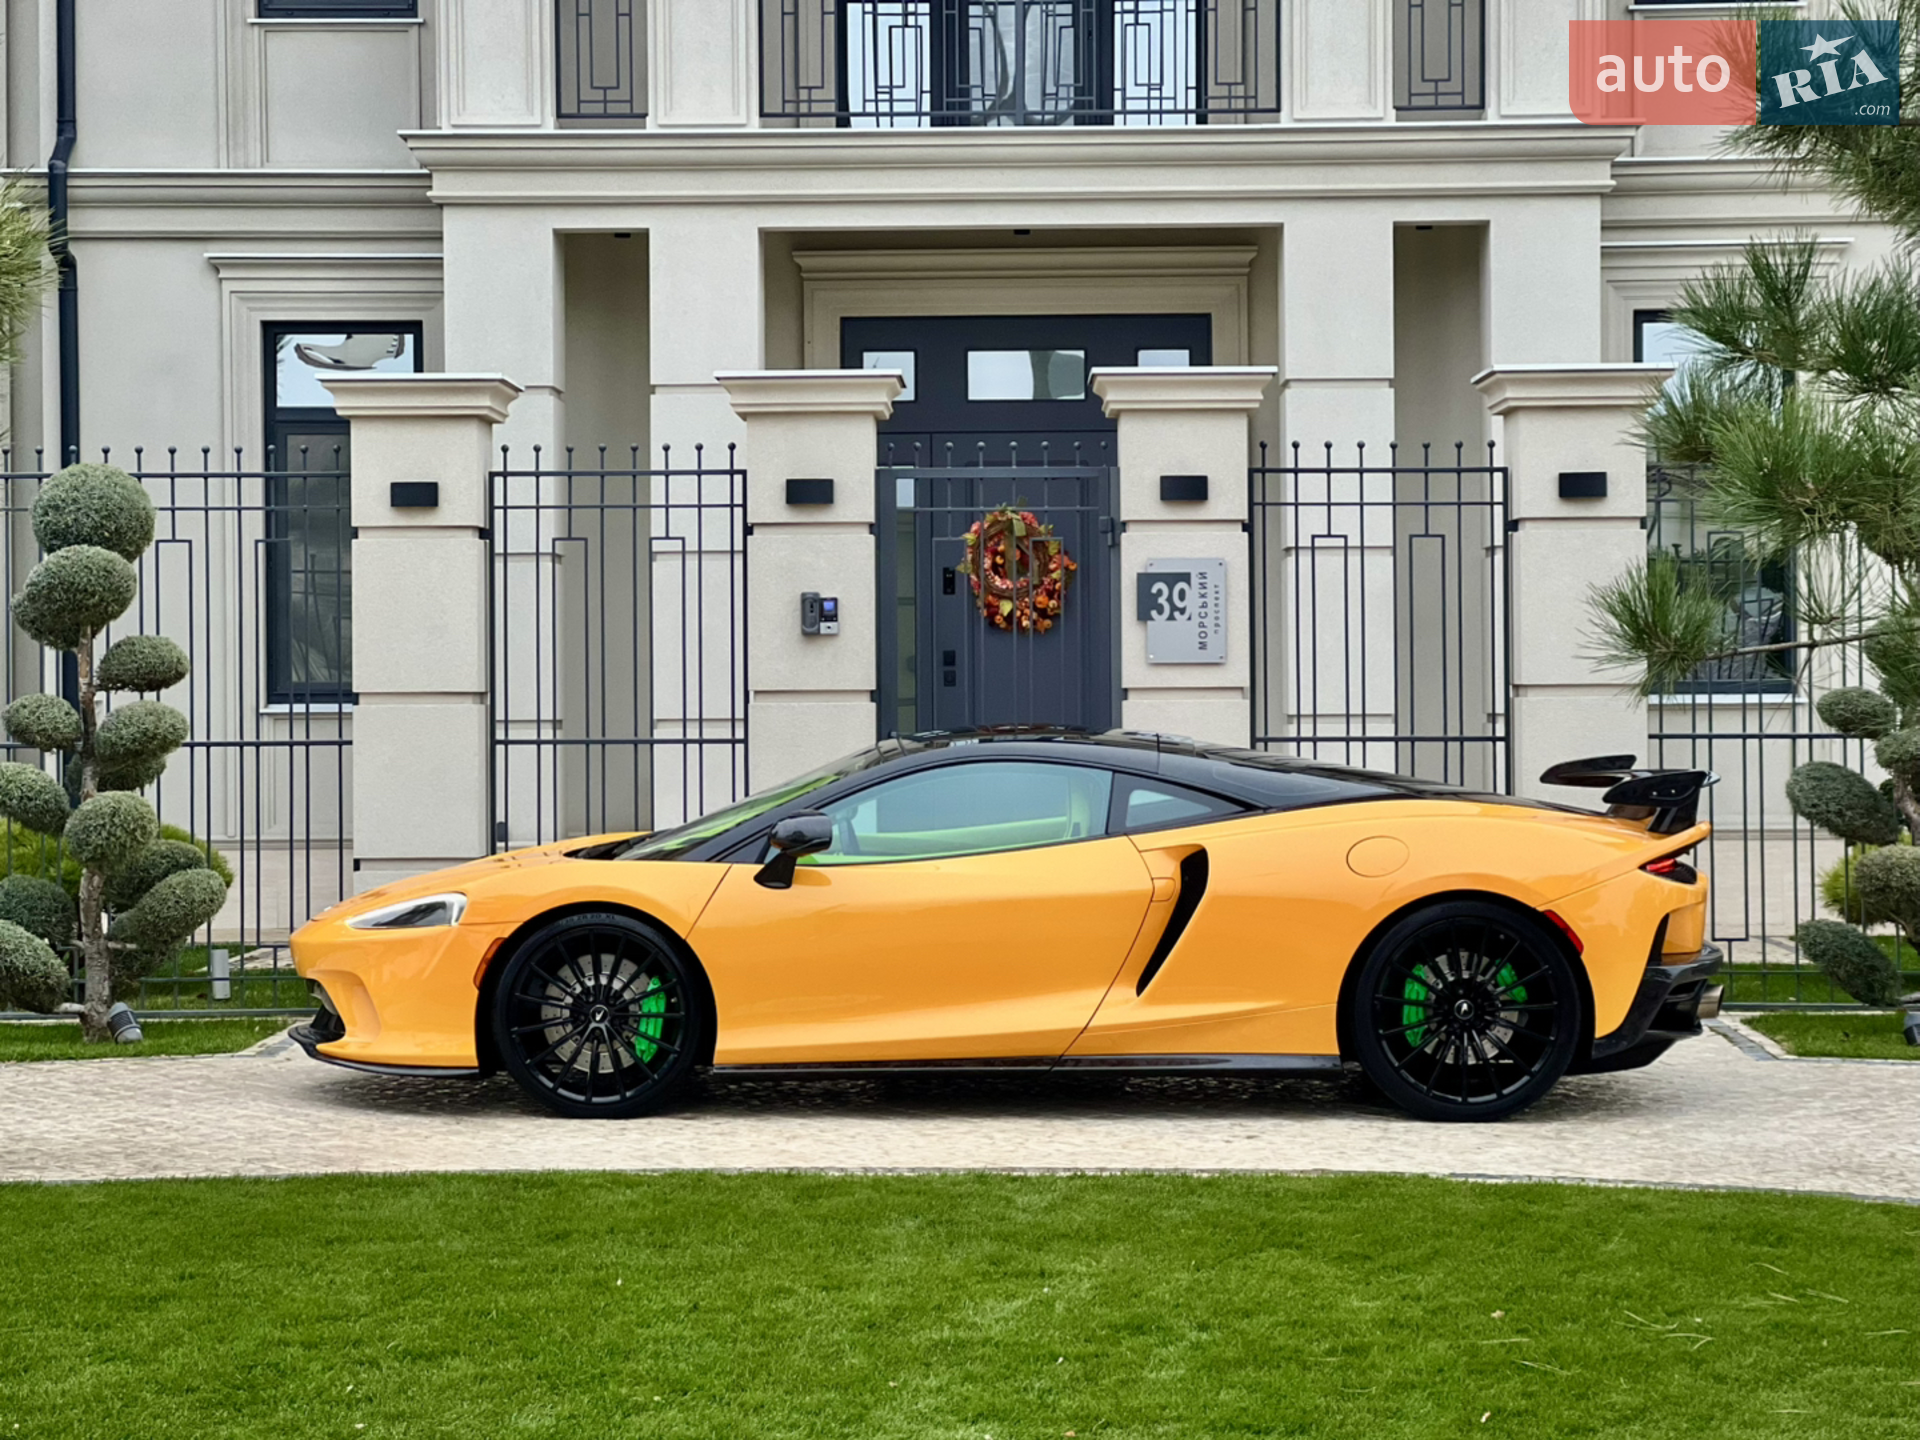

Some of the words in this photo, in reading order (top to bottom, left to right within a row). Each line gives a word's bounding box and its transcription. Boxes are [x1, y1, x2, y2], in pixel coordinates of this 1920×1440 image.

[1150, 580, 1192, 622] 39
[1196, 571, 1209, 651] МОРСЬКИЙ
[1213, 583, 1221, 635] проспект
